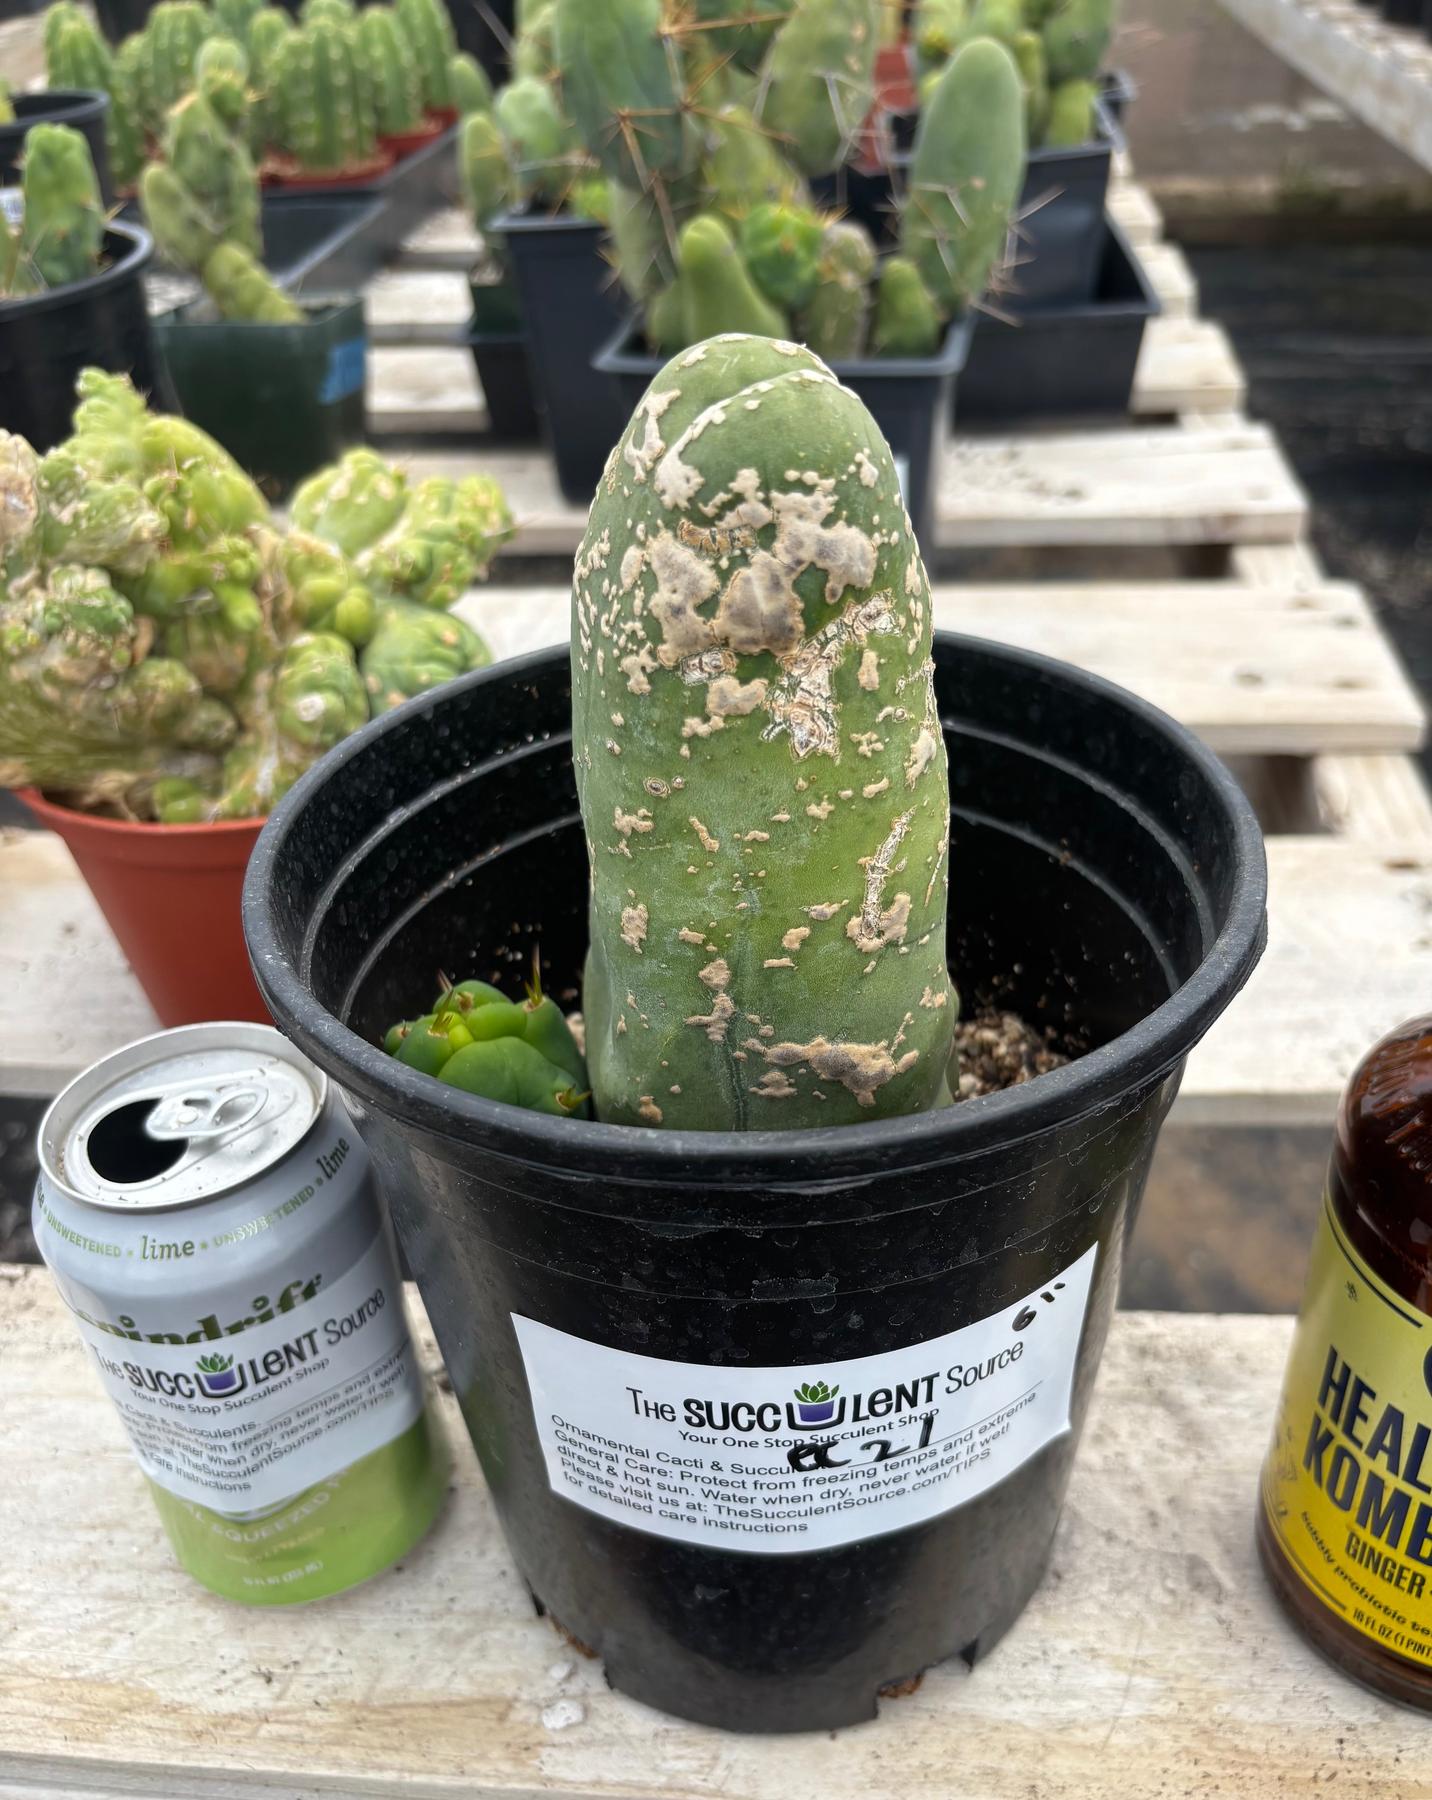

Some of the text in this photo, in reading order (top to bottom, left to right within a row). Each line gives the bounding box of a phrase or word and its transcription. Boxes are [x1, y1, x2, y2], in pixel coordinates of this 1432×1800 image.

[48, 1211, 122, 1257] UNSWEETENED
[141, 1235, 195, 1260] lime
[316, 1137, 350, 1180] lime
[325, 1288, 386, 1347] Source
[130, 1358, 330, 1415] Your One Stop Succulent Shop
[296, 1392, 341, 1418] temps
[345, 1373, 371, 1394] and
[945, 1341, 1024, 1394] Source
[208, 1452, 248, 1467] when
[281, 1415, 322, 1440] never
[325, 1393, 363, 1417] water
[551, 1414, 650, 1459] Ornamental
[656, 1452, 704, 1469] Cacti
[710, 1460, 724, 1472] &
[555, 1392, 1036, 1490] General Care: Protect from freezing temps and extreme
[678, 1408, 940, 1449] Your One Stop Succulent Shop
[176, 1466, 251, 1491] instructions
[557, 1422, 1010, 1505] direct & hot sun. Water when dry, never water if wet!
[560, 1448, 991, 1519] Please visit us at: TheSucculentSource.com/TIPS
[564, 1471, 808, 1533] for detailed care instructions
[1345, 1530, 1426, 1600] GINGER
[1334, 1566, 1407, 1625] probiotic
